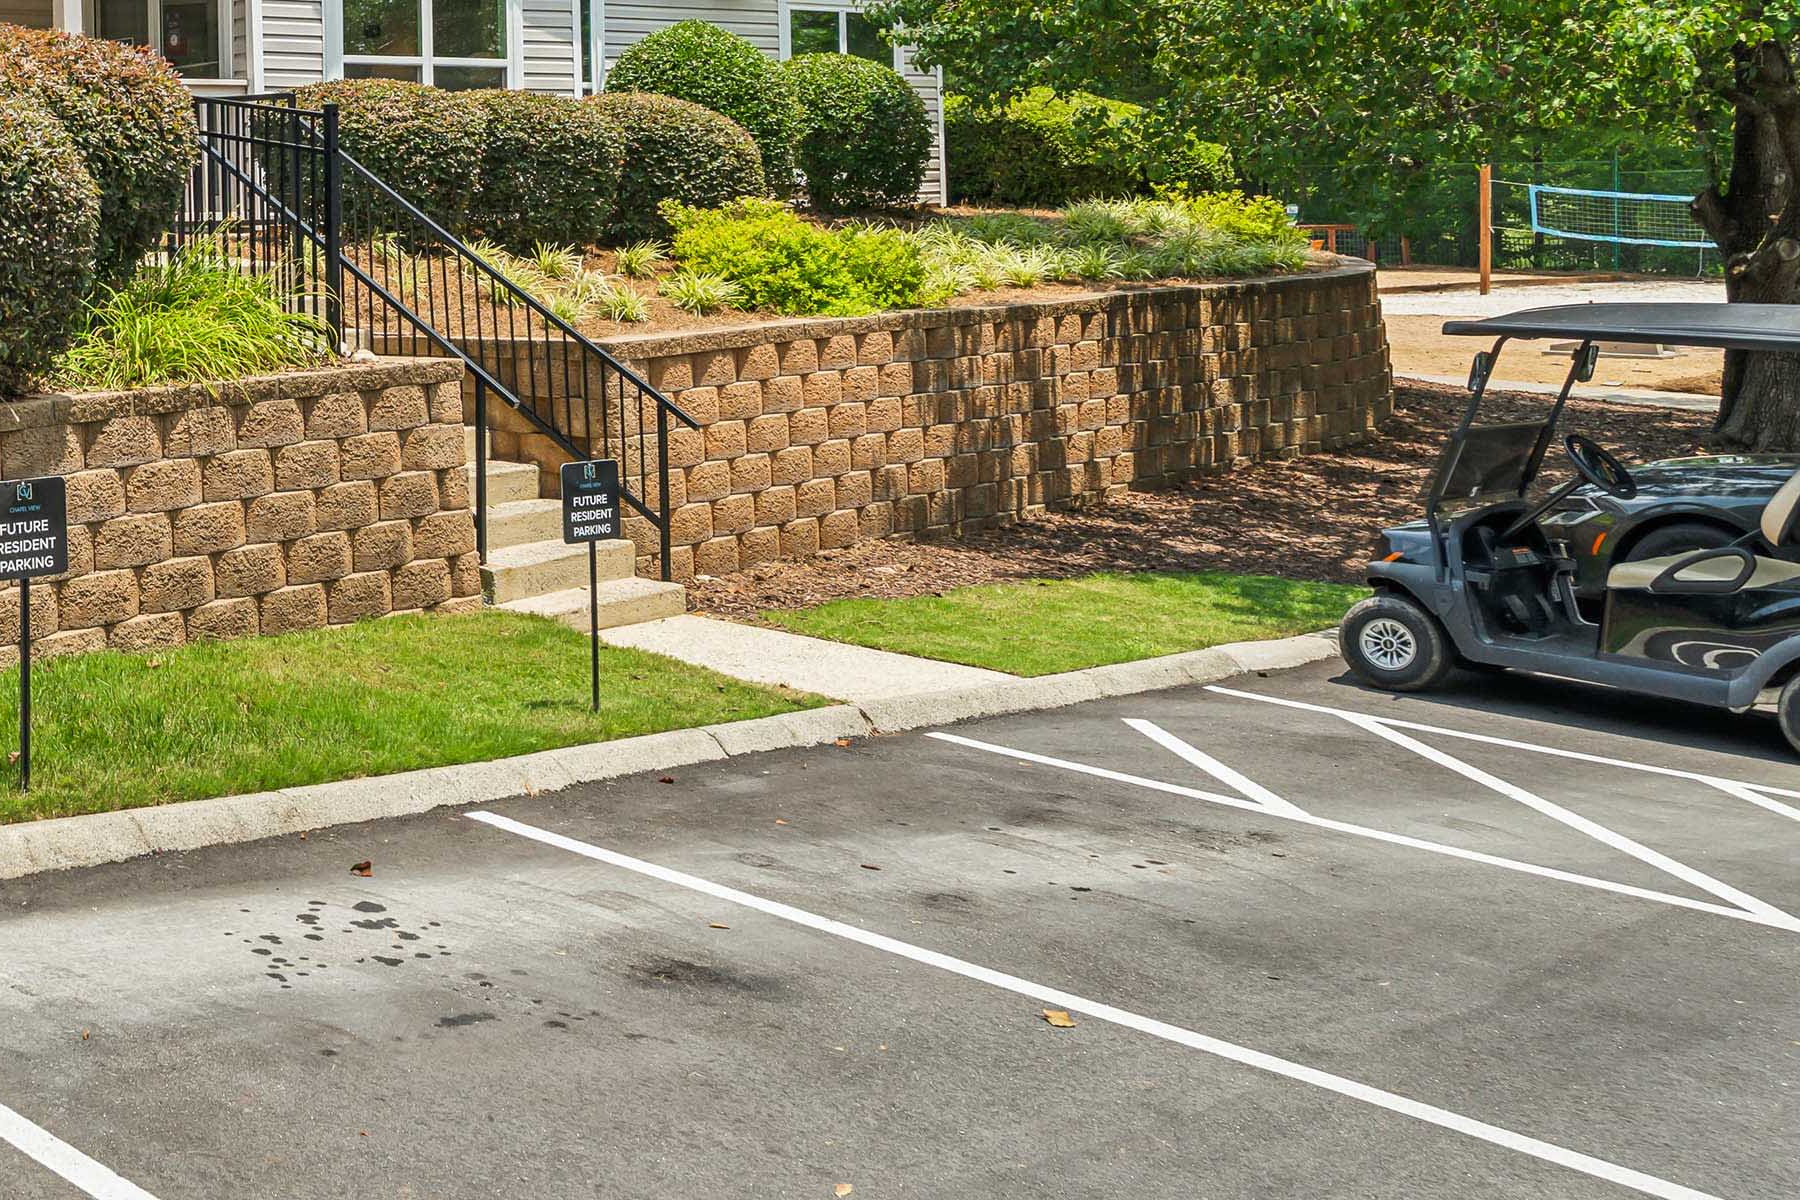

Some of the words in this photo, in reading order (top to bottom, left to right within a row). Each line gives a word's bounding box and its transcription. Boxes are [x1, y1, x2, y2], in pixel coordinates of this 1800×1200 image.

[573, 494, 608, 507] FUTURE
[571, 508, 613, 522] RESIDENT
[0, 519, 49, 536] FUTURE
[573, 523, 611, 537] PARKING
[0, 555, 54, 573] PARKING
